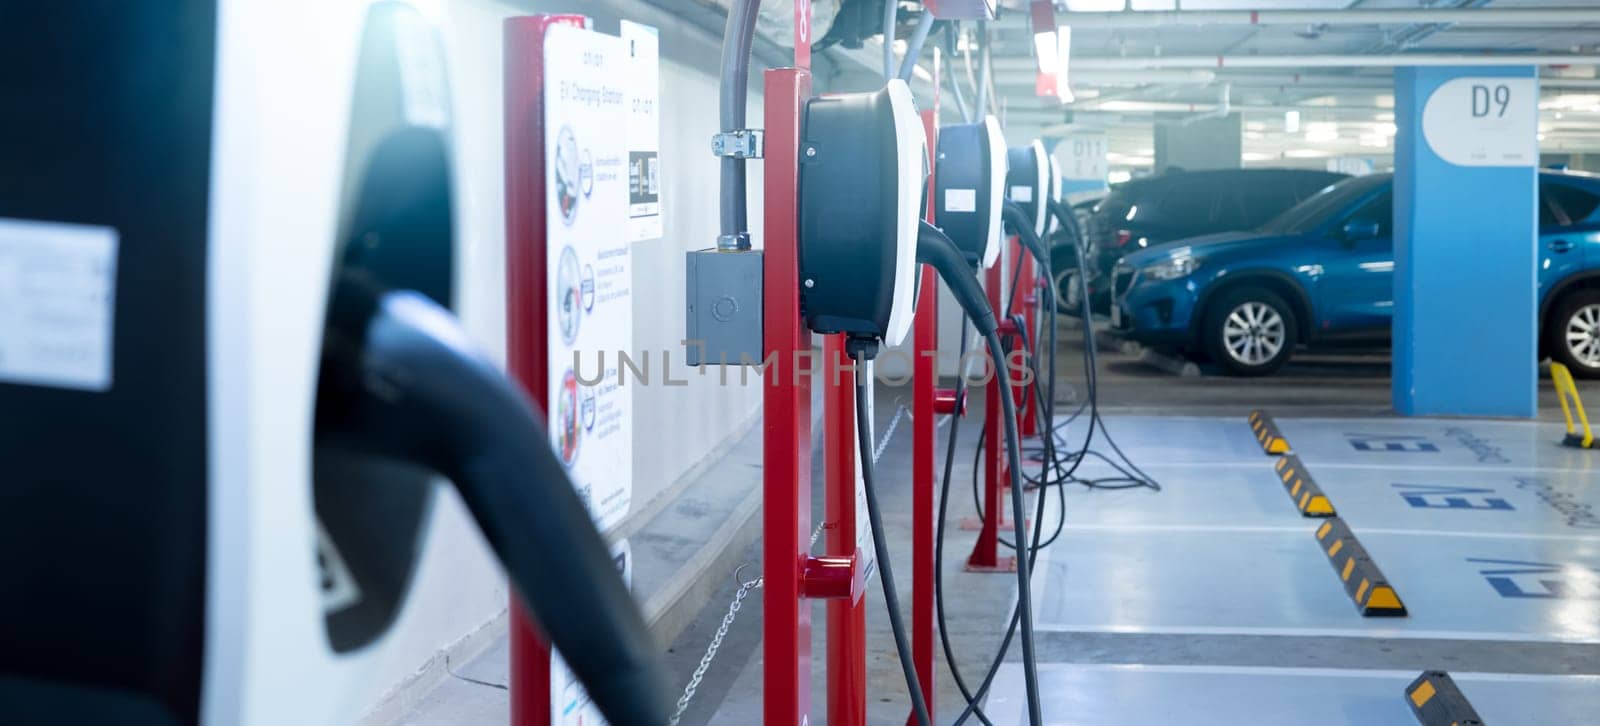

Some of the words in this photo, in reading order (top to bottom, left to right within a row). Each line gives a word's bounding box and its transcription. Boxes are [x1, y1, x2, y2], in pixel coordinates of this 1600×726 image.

[572, 83, 601, 108] Charging
[602, 85, 624, 104] Station
[1472, 84, 1510, 118] D9
[1342, 432, 1441, 452] EV
[1391, 483, 1516, 511] EV
